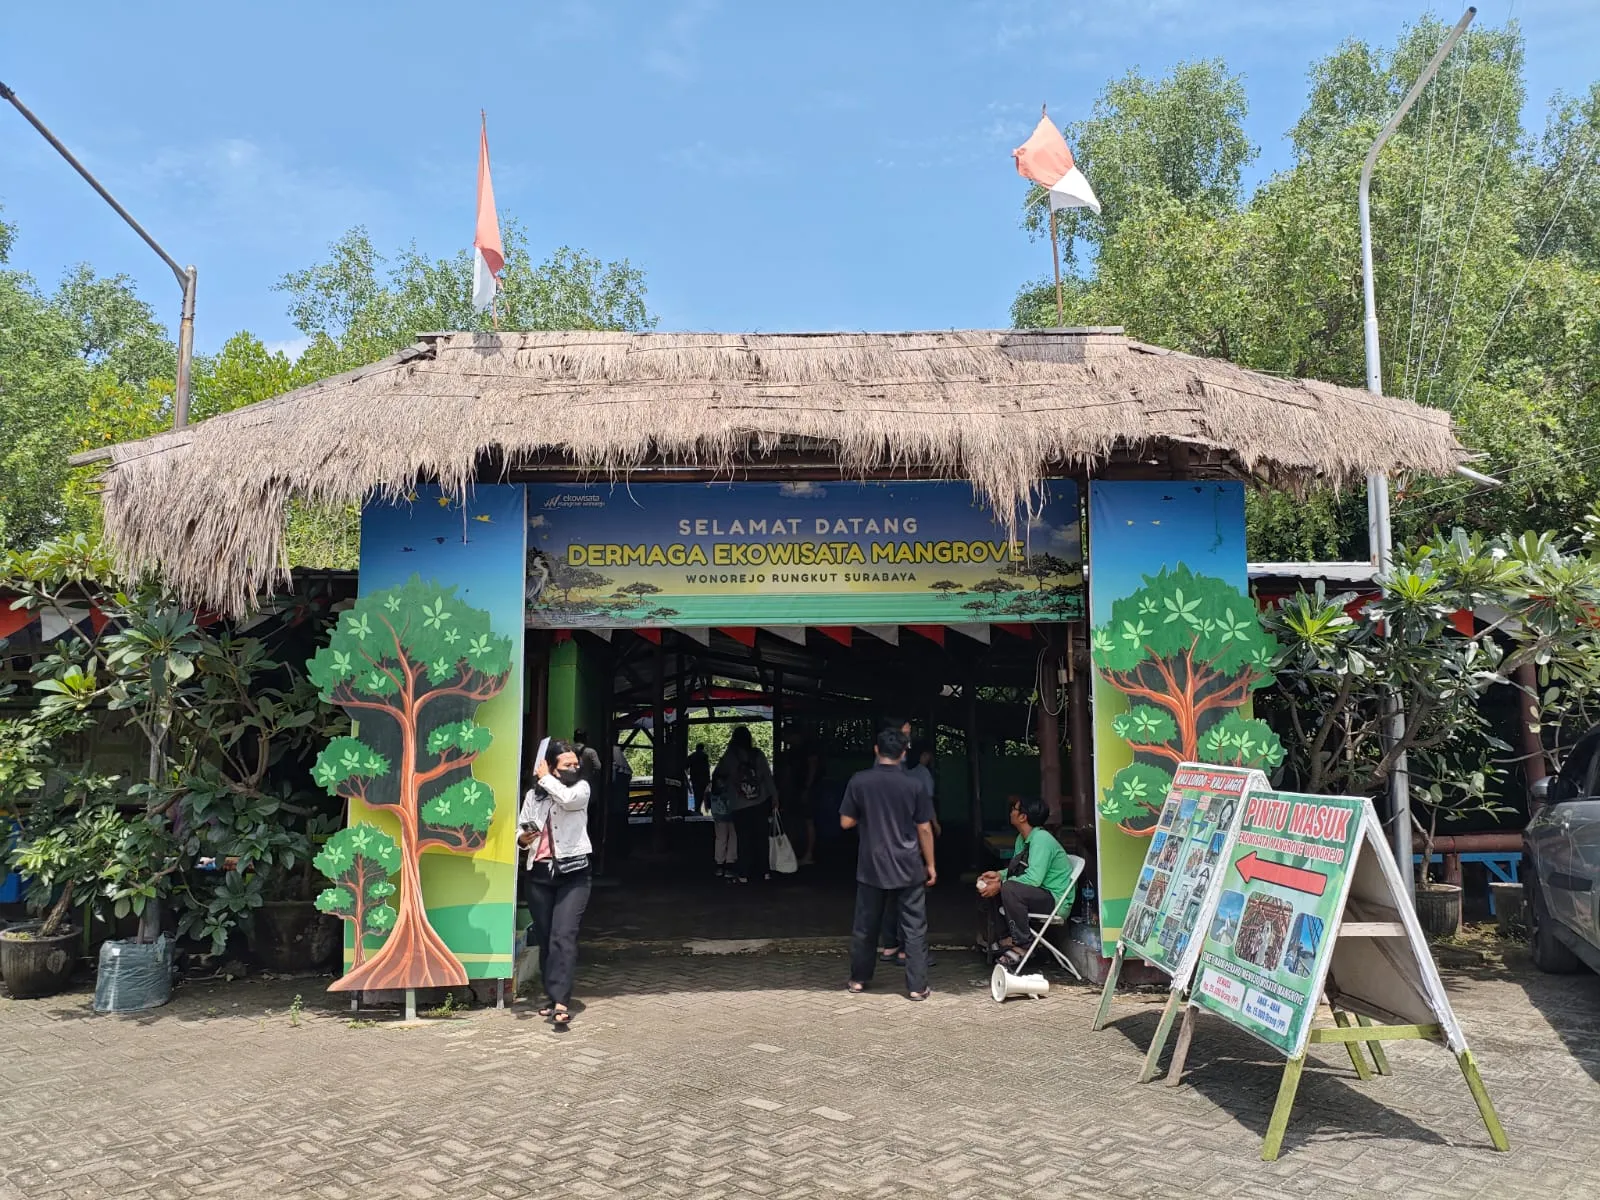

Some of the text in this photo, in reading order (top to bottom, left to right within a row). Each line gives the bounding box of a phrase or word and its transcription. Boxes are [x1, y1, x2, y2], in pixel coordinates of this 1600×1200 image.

[563, 494, 600, 502] ekowisata
[679, 517, 918, 536] SELAMAT DATANG
[568, 541, 1025, 566] DERMAGA EKOWISATA MANGROVE
[686, 572, 917, 584] WONOREJO RUNGKUT SURABAYA
[1243, 797, 1353, 843] PINTU MASUK
[1238, 831, 1345, 865] EKOWISATA MANGROVE WONOREJO
[1277, 984, 1305, 1006] MANGROVE
